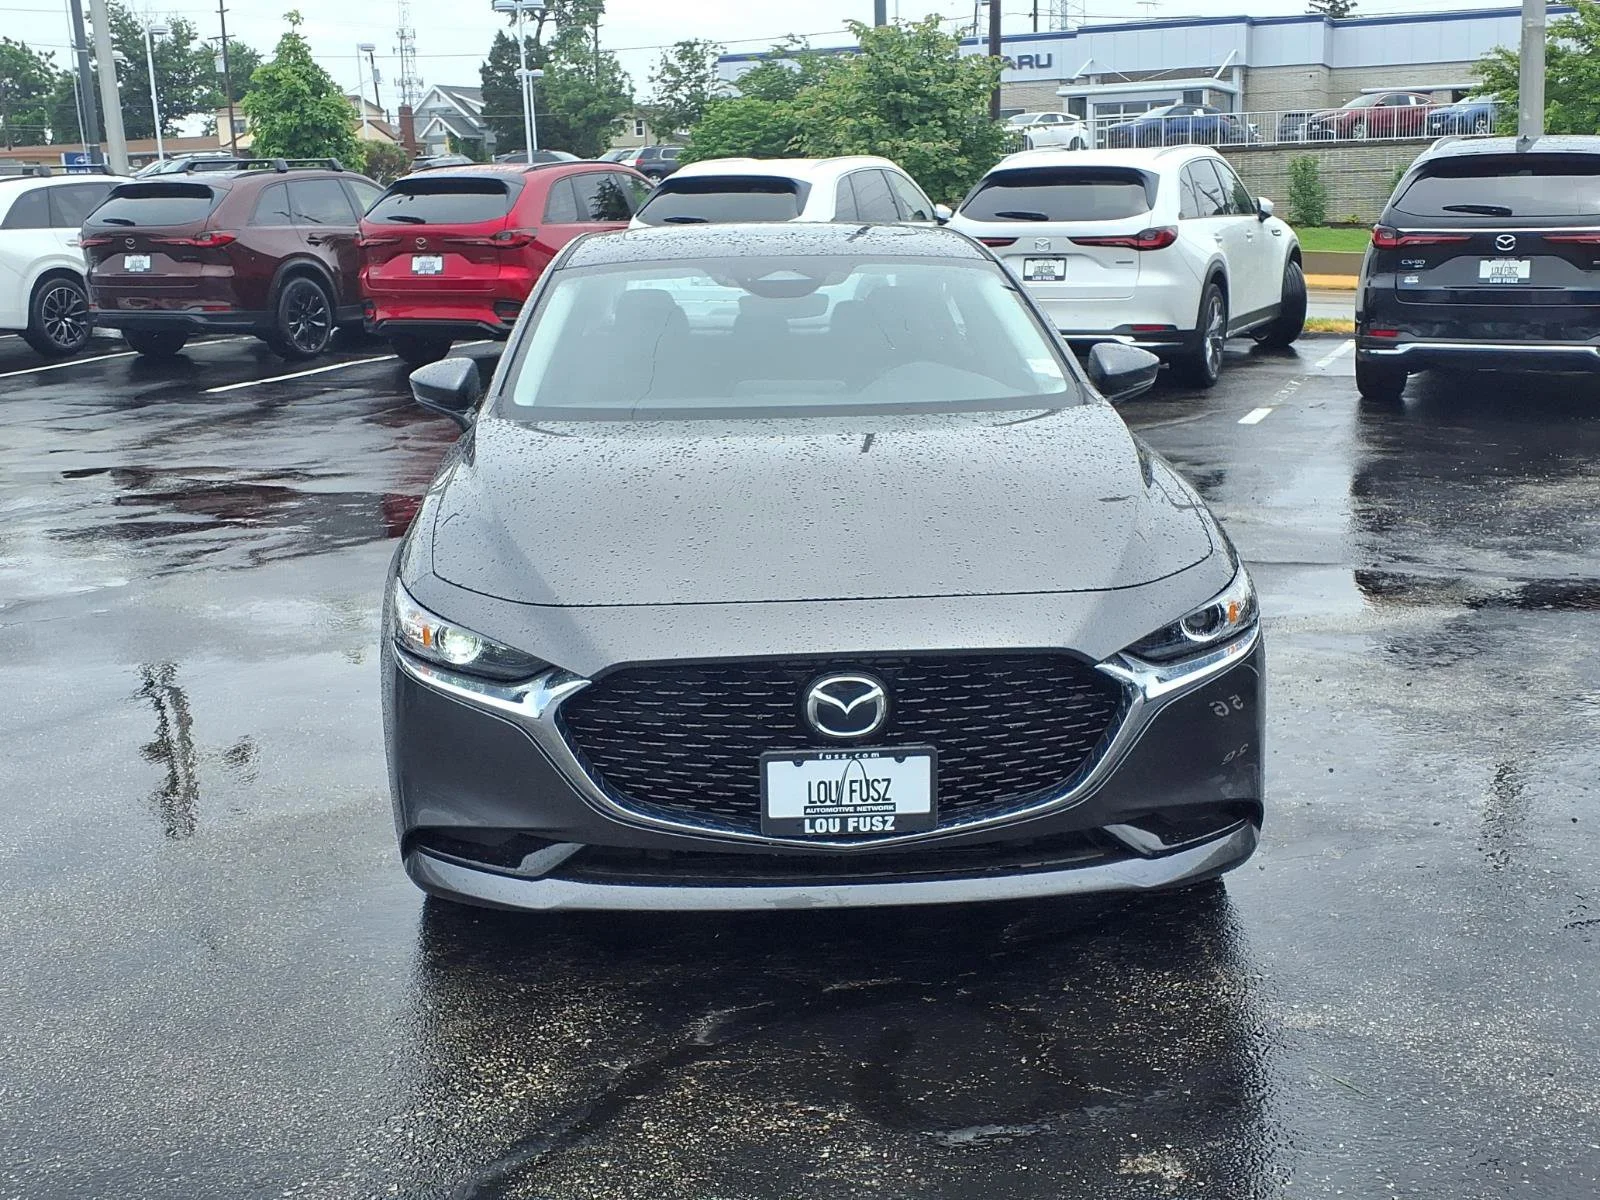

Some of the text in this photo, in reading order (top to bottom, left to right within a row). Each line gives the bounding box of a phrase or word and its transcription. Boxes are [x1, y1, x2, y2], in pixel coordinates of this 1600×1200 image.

[818, 752, 880, 760] fusz.com
[807, 778, 892, 805] LOU FUSZ
[805, 804, 895, 814] AUTOMOTIVE NETWORK
[804, 815, 896, 834] LOU FUSZ
